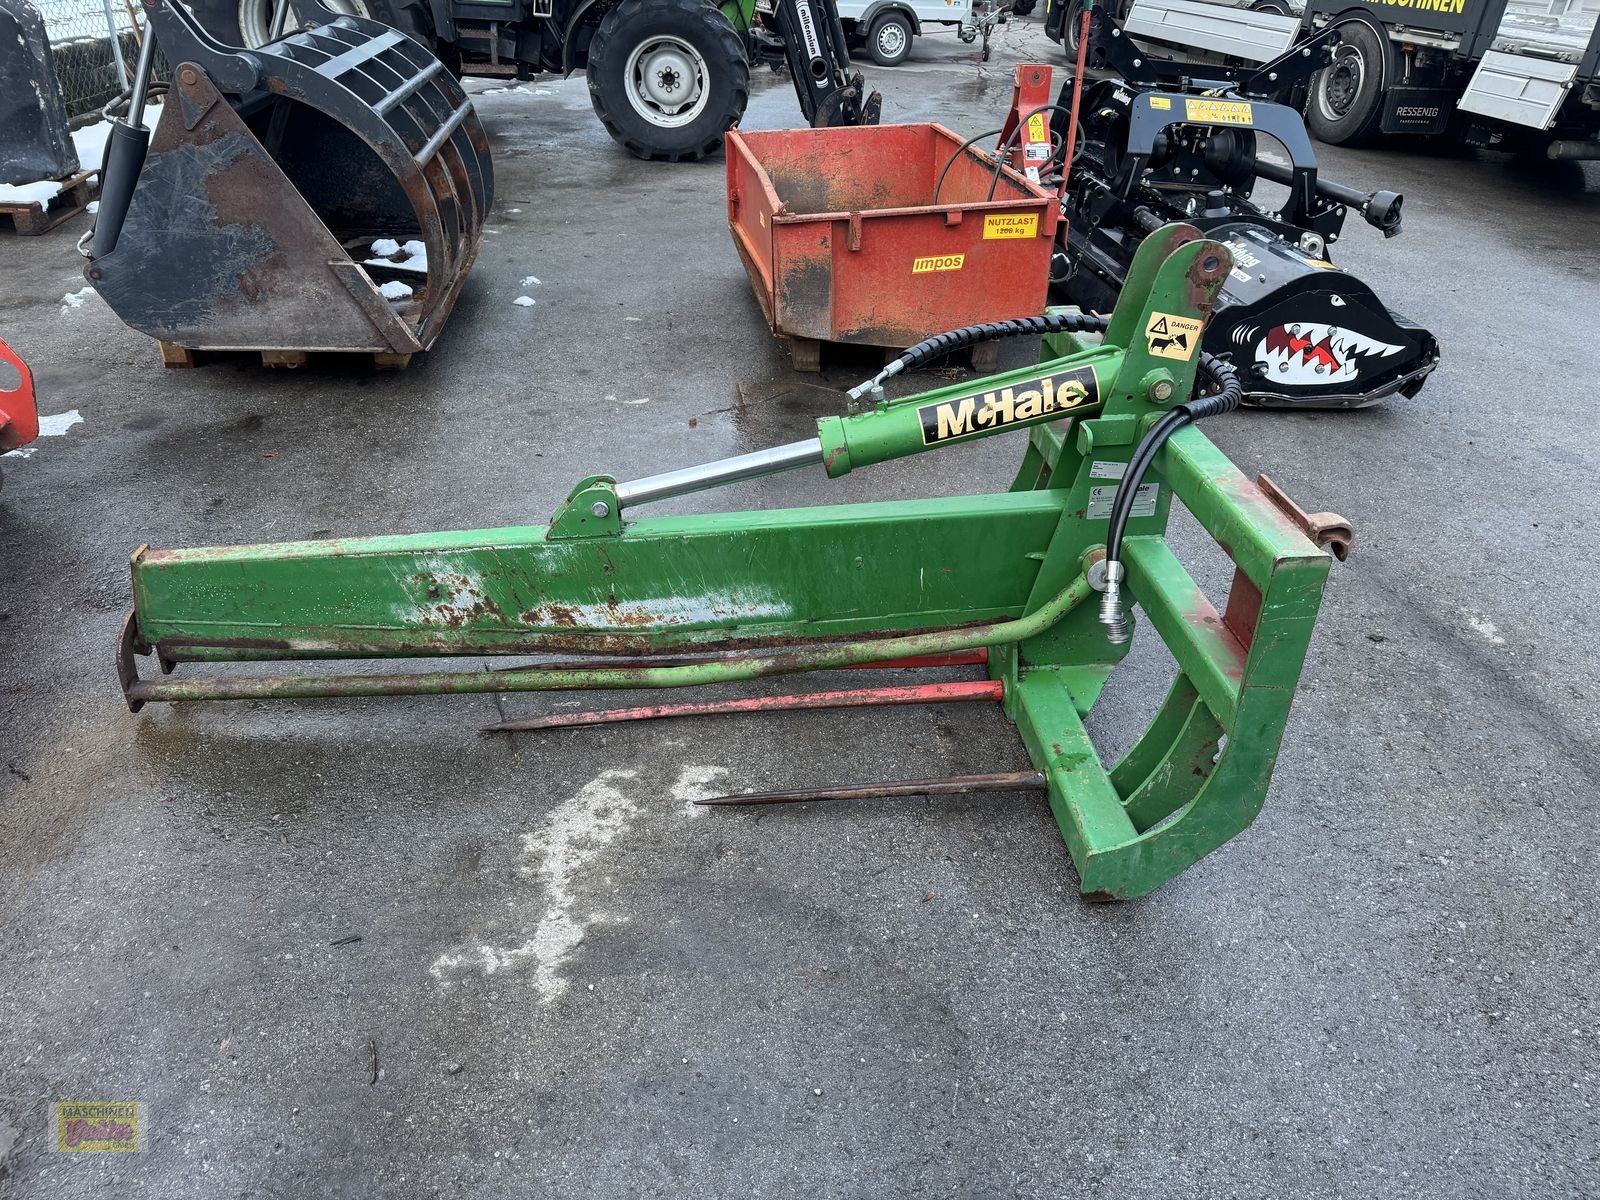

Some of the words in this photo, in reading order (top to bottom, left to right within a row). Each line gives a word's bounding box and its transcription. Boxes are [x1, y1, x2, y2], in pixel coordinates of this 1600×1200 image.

[800, 9, 817, 55] millennium
[1396, 106, 1439, 117] RESSENIG
[988, 217, 1035, 227] NUTZLAST
[1015, 227, 1025, 235] kg
[915, 256, 962, 271] impos
[1171, 321, 1199, 332] DANGER
[936, 377, 1089, 440] McHale
